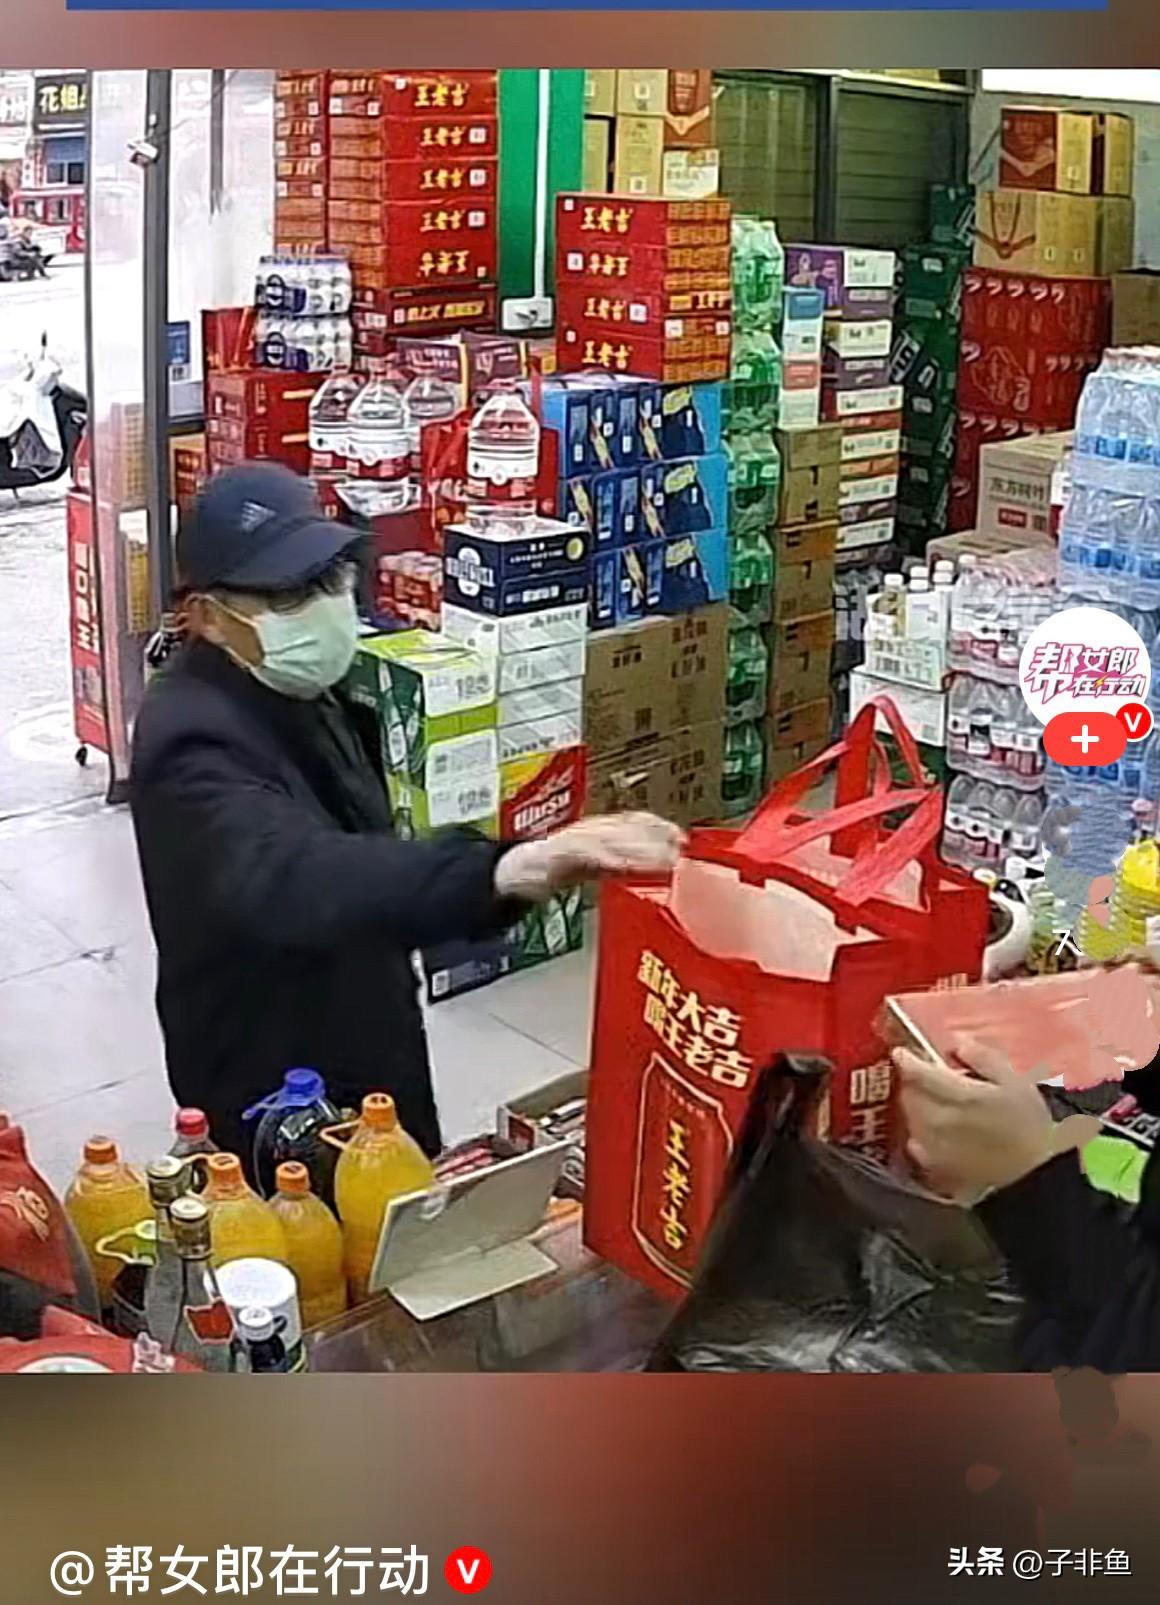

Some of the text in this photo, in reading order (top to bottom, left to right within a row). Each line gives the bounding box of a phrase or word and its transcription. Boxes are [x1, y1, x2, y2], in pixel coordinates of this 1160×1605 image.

[415, 77, 469, 107] 王老吉
[580, 206, 633, 233] 王老吉
[581, 341, 634, 370] 王老吉
[636, 949, 744, 1047] 新年大吉
[659, 1119, 693, 1250] 王老吉
